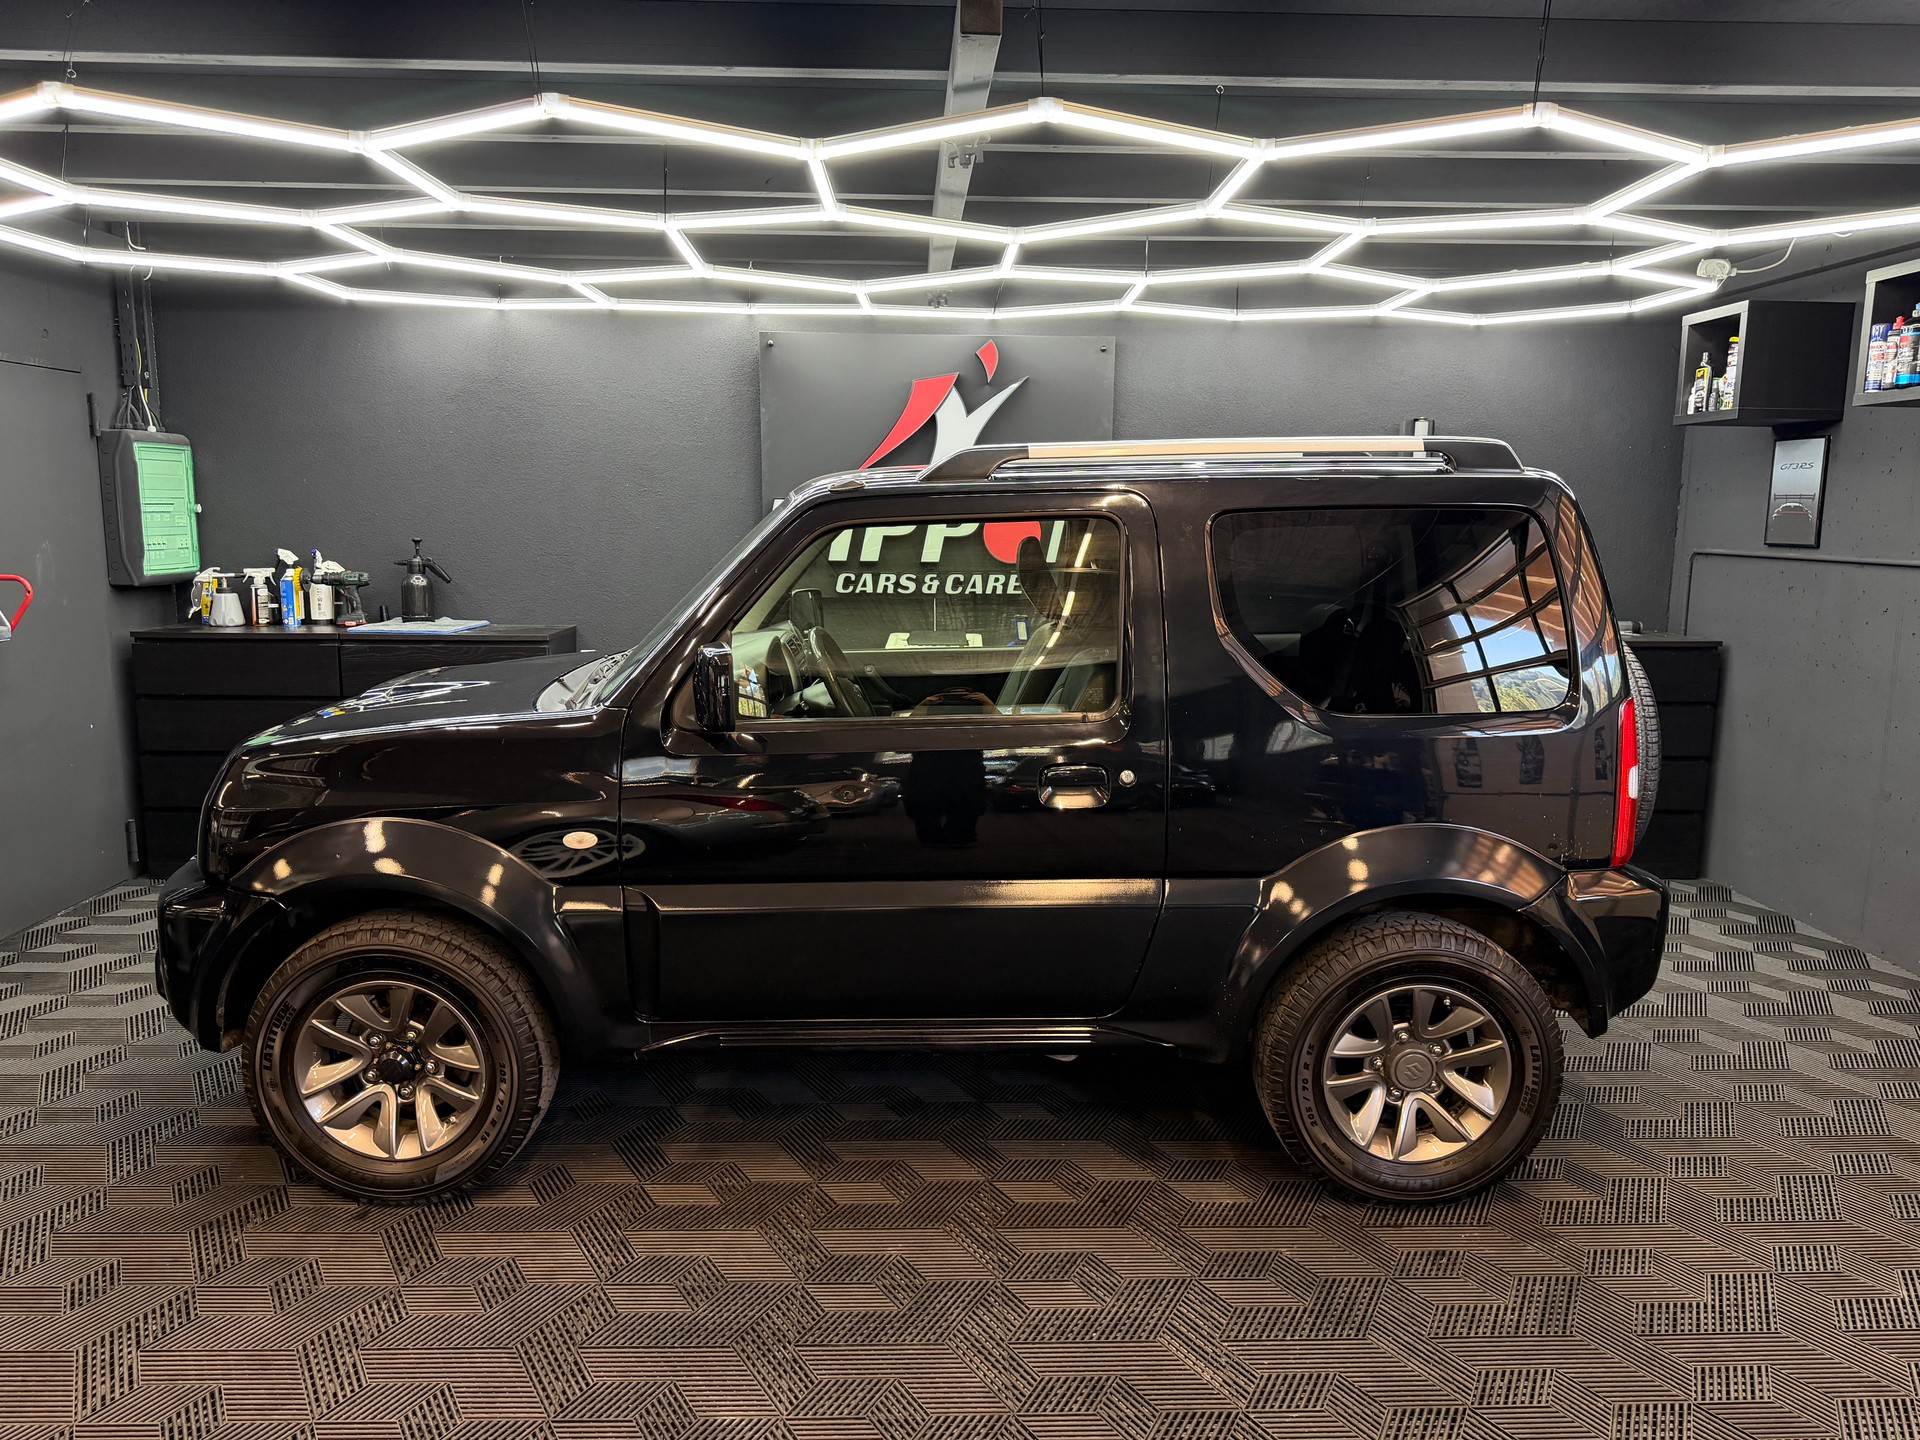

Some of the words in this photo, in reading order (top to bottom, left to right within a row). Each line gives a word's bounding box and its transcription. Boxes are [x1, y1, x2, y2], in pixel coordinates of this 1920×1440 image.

[280, 1005, 298, 1032] CROSS
[262, 1000, 293, 1072] LATITUDE
[1306, 1043, 1316, 1057] 15
[1522, 1045, 1541, 1118] LATITUDE
[1518, 1085, 1532, 1114] CROSS
